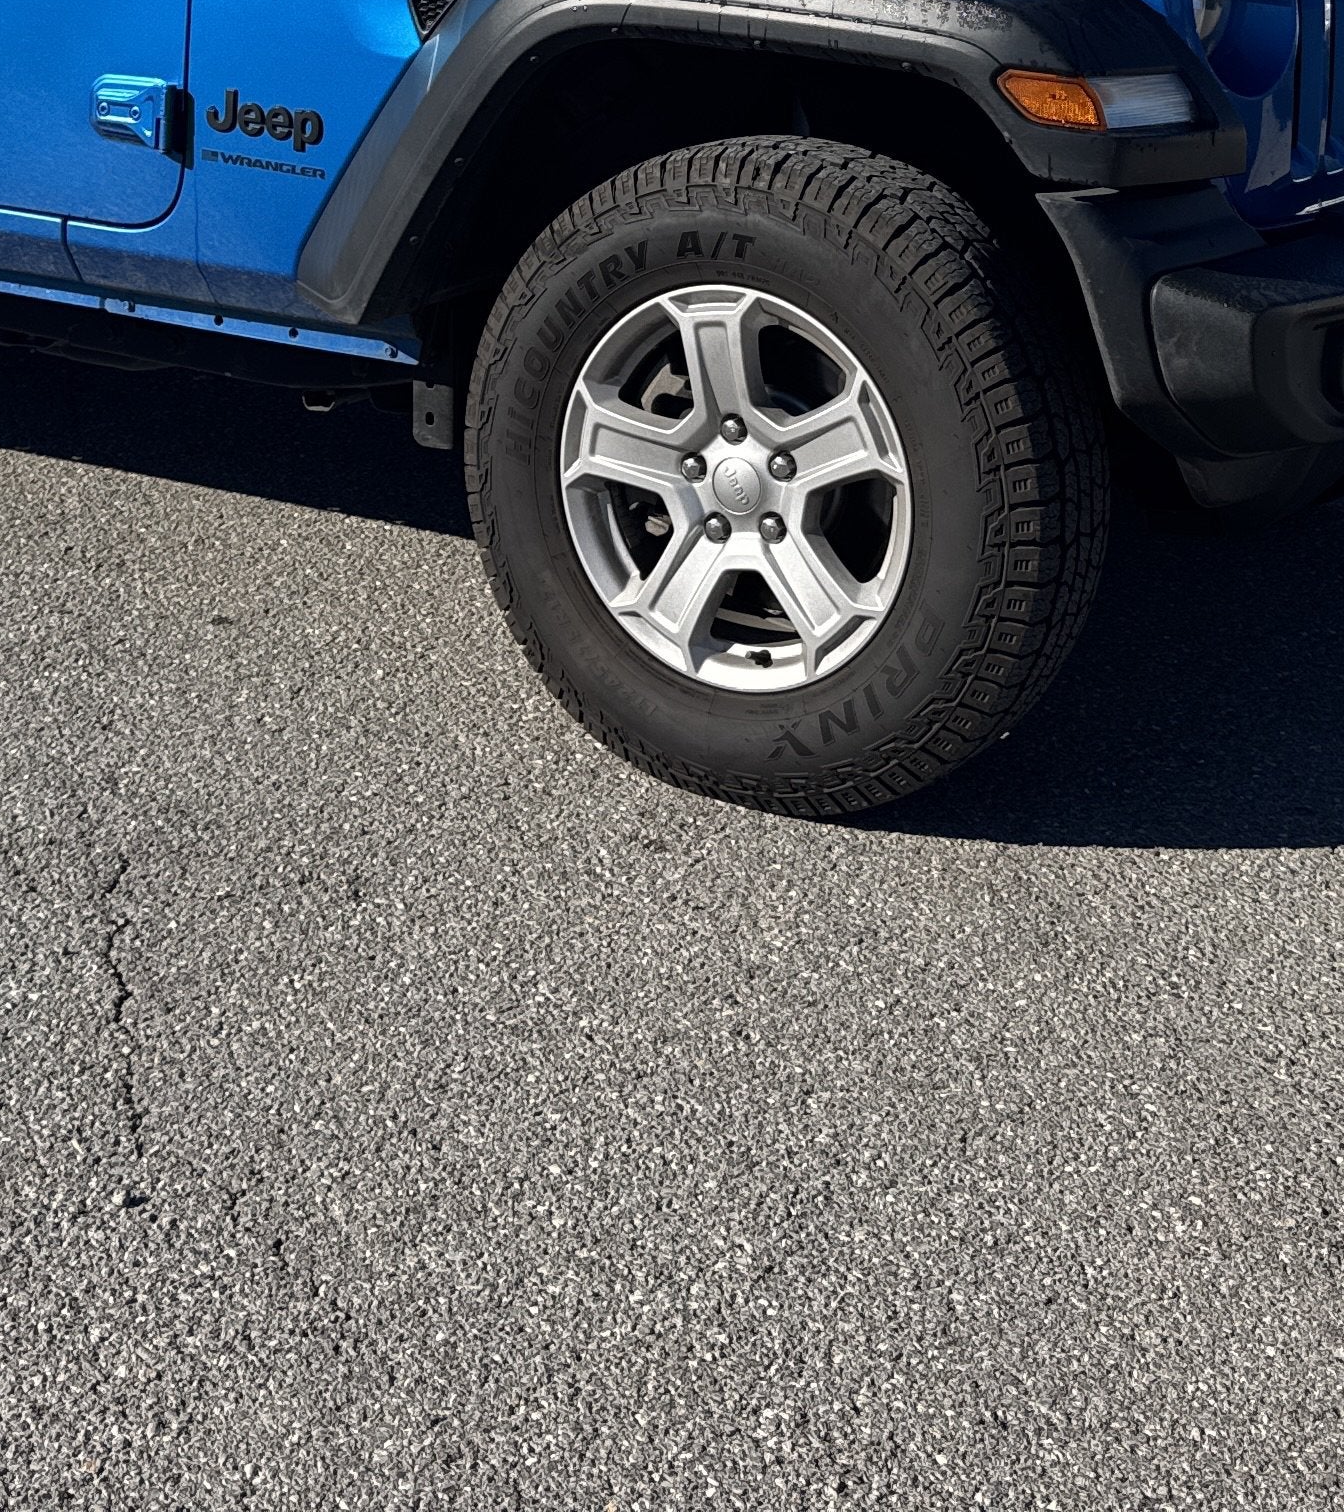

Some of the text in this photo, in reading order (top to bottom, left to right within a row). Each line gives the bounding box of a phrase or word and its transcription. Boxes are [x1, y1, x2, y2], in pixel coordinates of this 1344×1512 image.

[207, 88, 323, 153] Jeep
[219, 151, 326, 180] WRANGLER
[676, 230, 756, 260] A/T
[724, 467, 750, 506] Jeep
